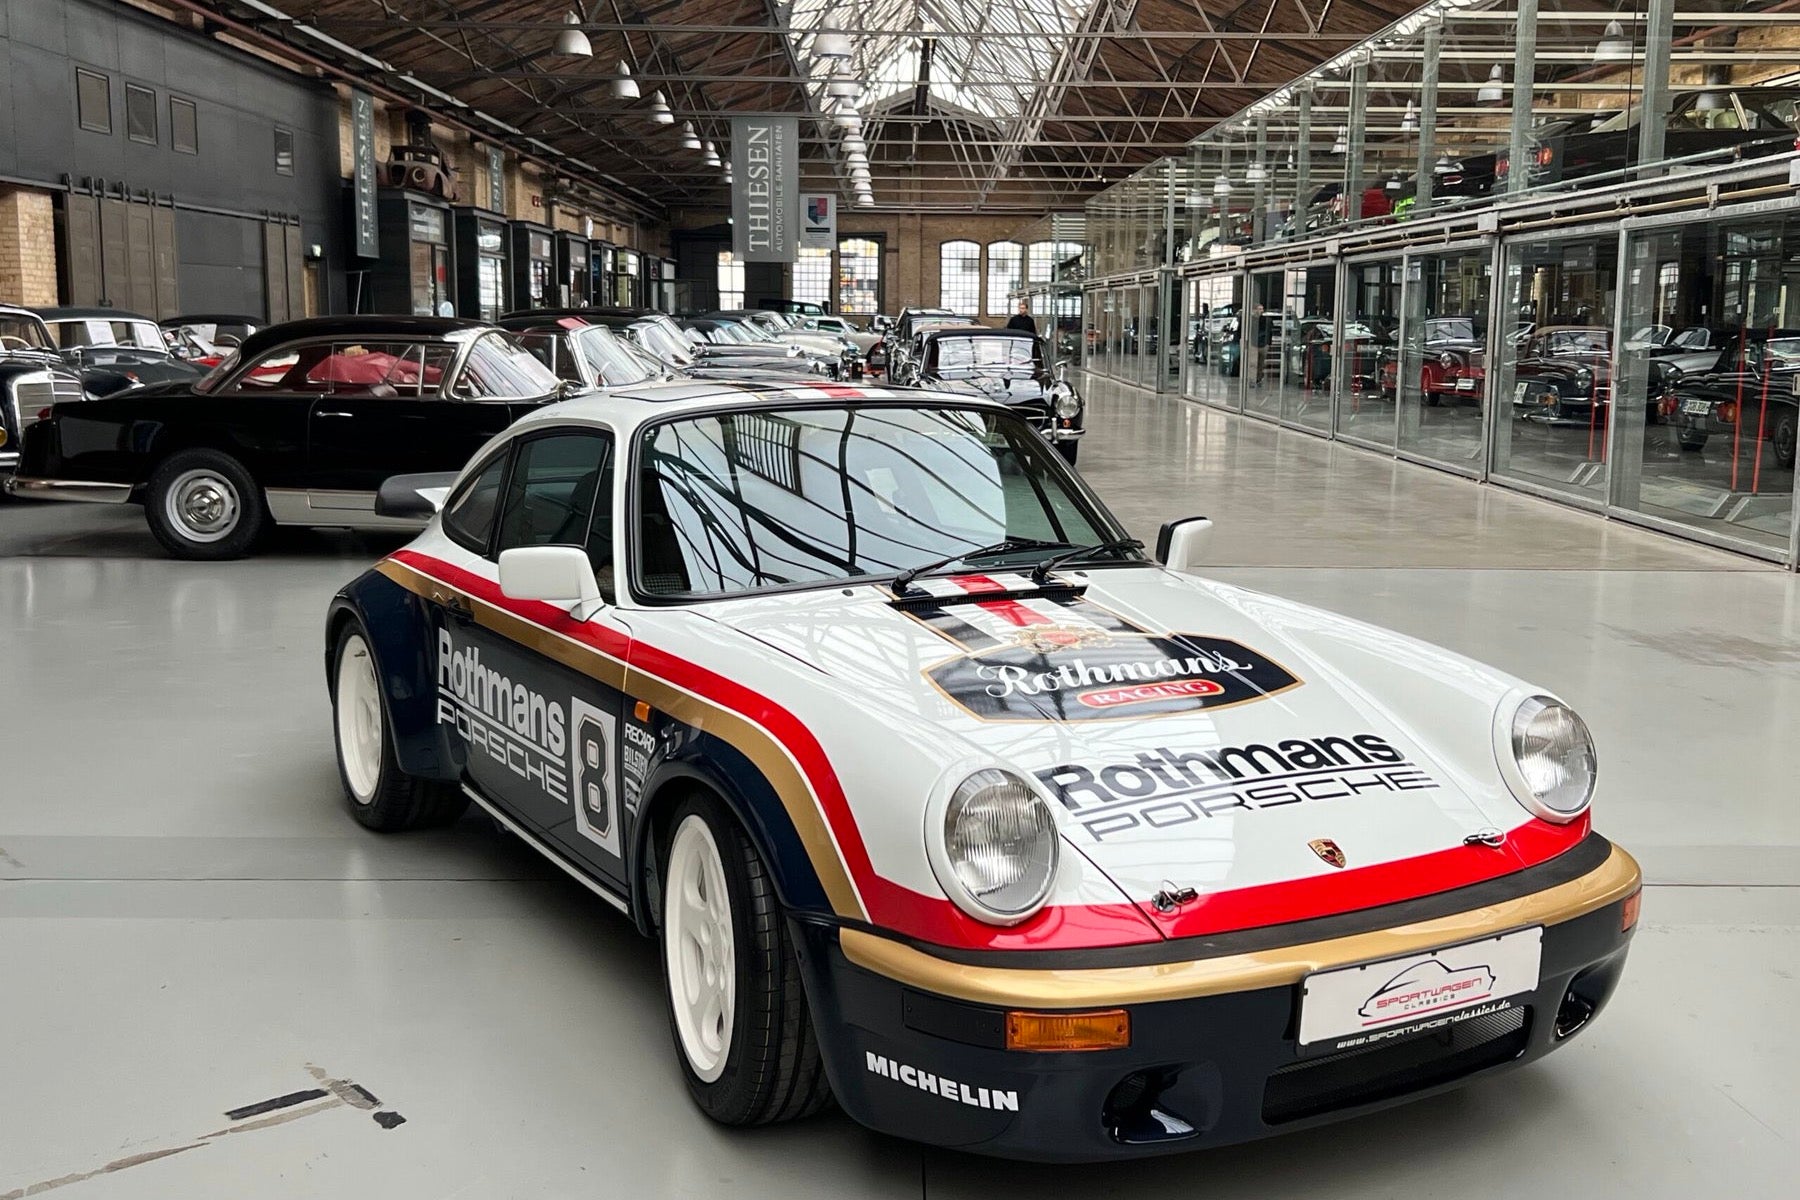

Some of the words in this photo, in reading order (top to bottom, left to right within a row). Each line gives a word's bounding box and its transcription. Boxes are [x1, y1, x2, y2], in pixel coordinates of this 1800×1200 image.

[357, 97, 370, 245] THIESEN
[748, 125, 770, 252] THIESEN
[775, 185, 783, 252] AUTOMOBILE
[438, 627, 566, 757] Rothmans
[977, 650, 1253, 699] Rothmans
[1096, 681, 1210, 705] RACING
[437, 698, 568, 805] PORSCHE
[624, 722, 656, 754] RECARO
[1033, 733, 1406, 810] Rothmans
[577, 712, 611, 839] 8
[1081, 770, 1441, 842] PORSCHE
[1336, 1000, 1511, 1049] www.SPORTWAGENclassics.de
[1376, 977, 1482, 1009] SPORTWAGEN
[1404, 993, 1456, 1010] CLASSICS
[866, 1050, 1019, 1112] MICHELIN
